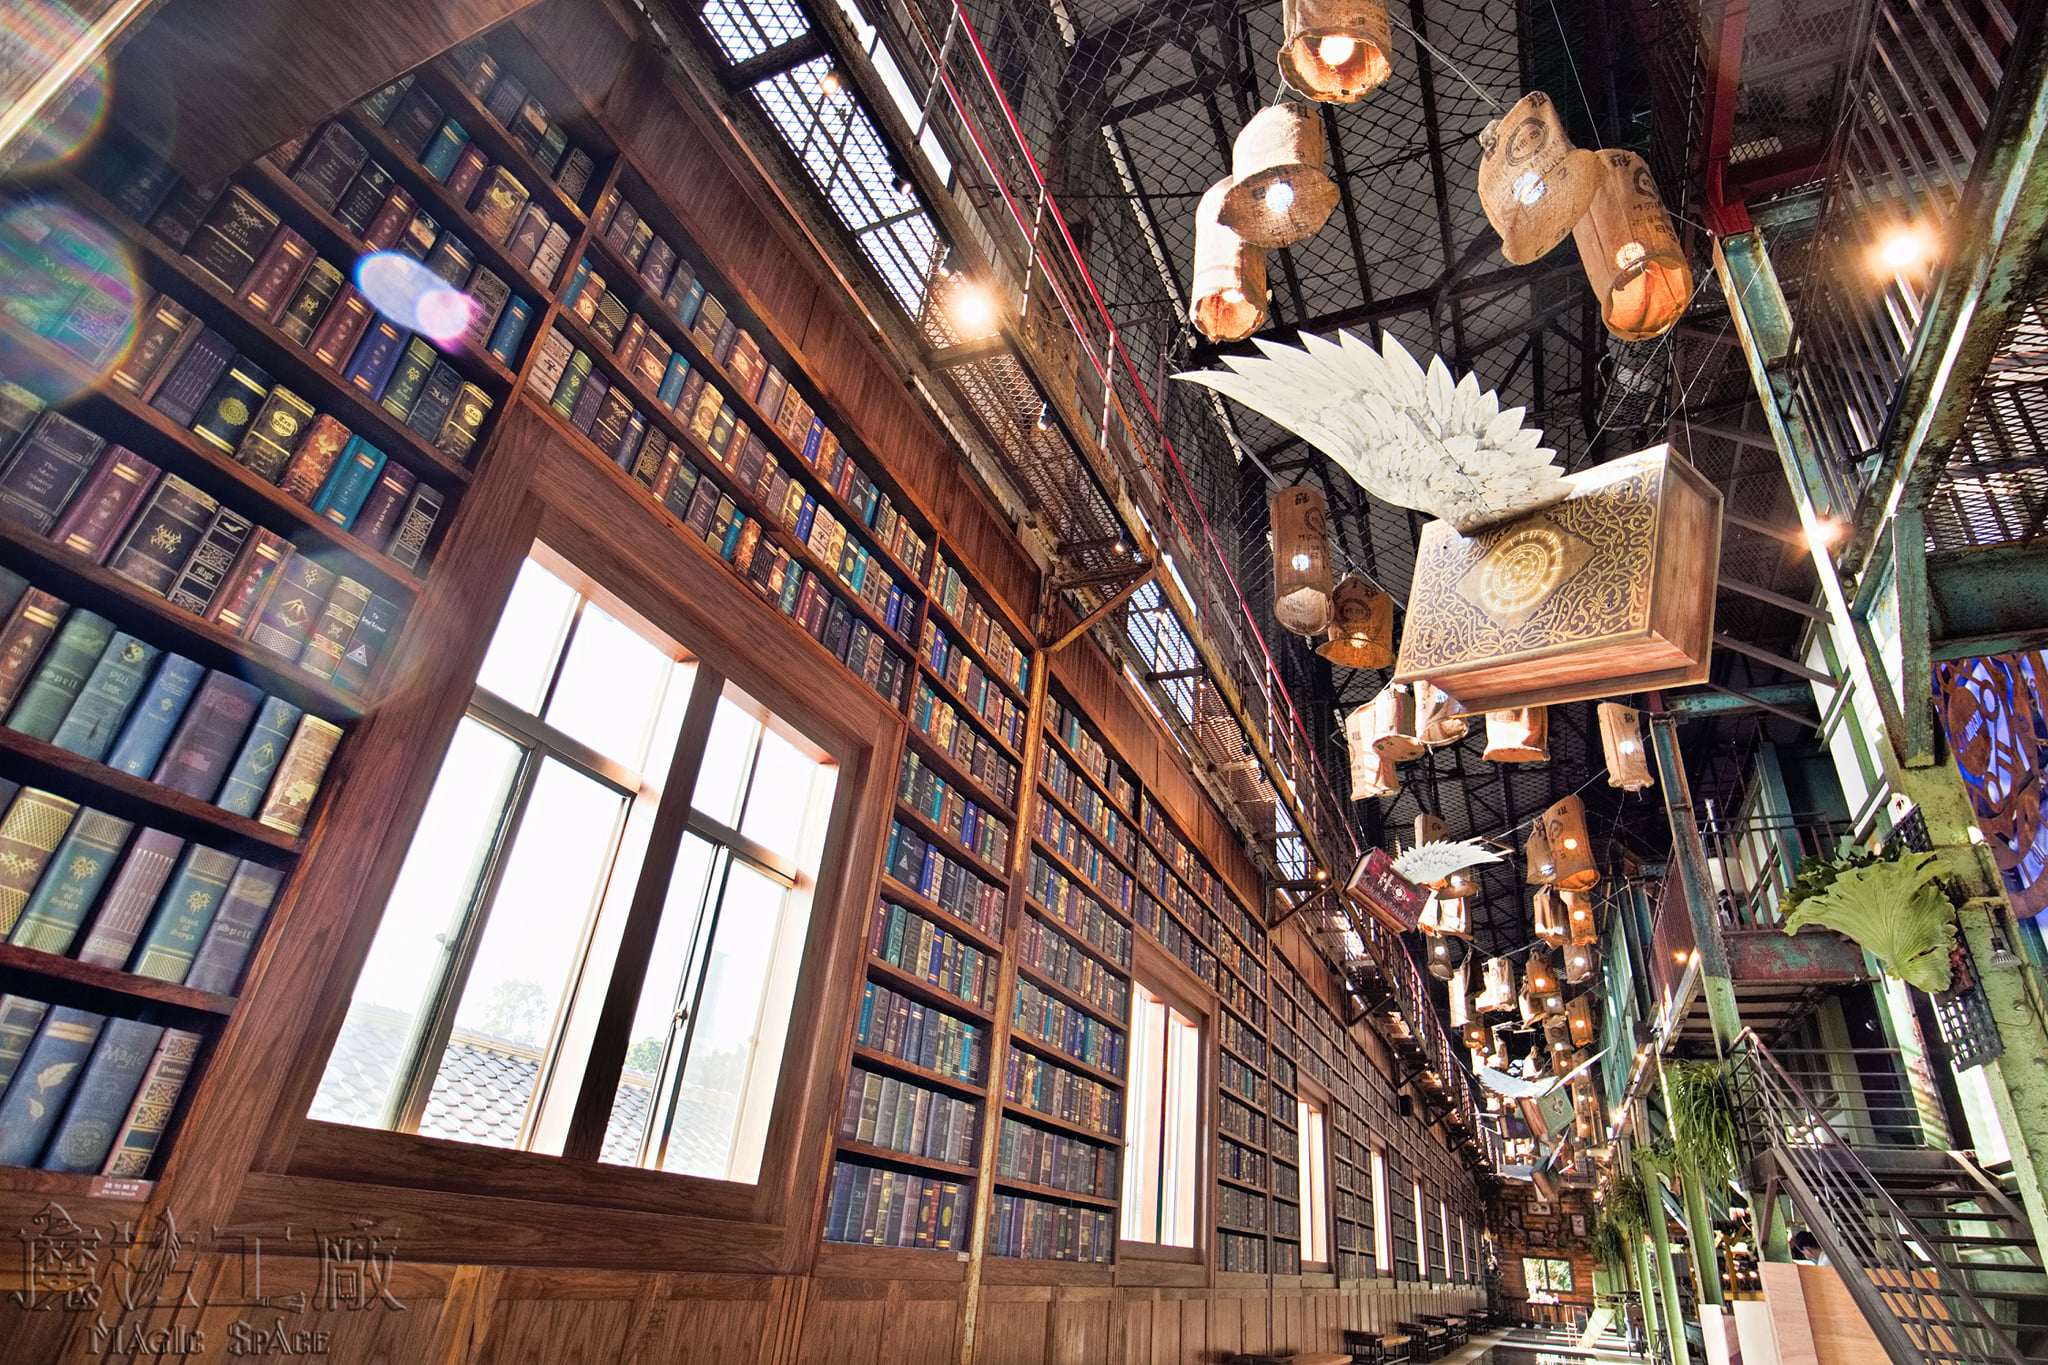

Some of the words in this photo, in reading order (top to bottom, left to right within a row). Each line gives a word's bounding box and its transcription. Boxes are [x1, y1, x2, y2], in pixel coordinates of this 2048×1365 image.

[272, 418, 294, 434] Drum
[276, 414, 293, 429] Ten
[196, 566, 215, 582] Magic
[40, 669, 79, 690] Spell
[217, 922, 252, 939] Spell
[100, 1045, 145, 1069] Magic
